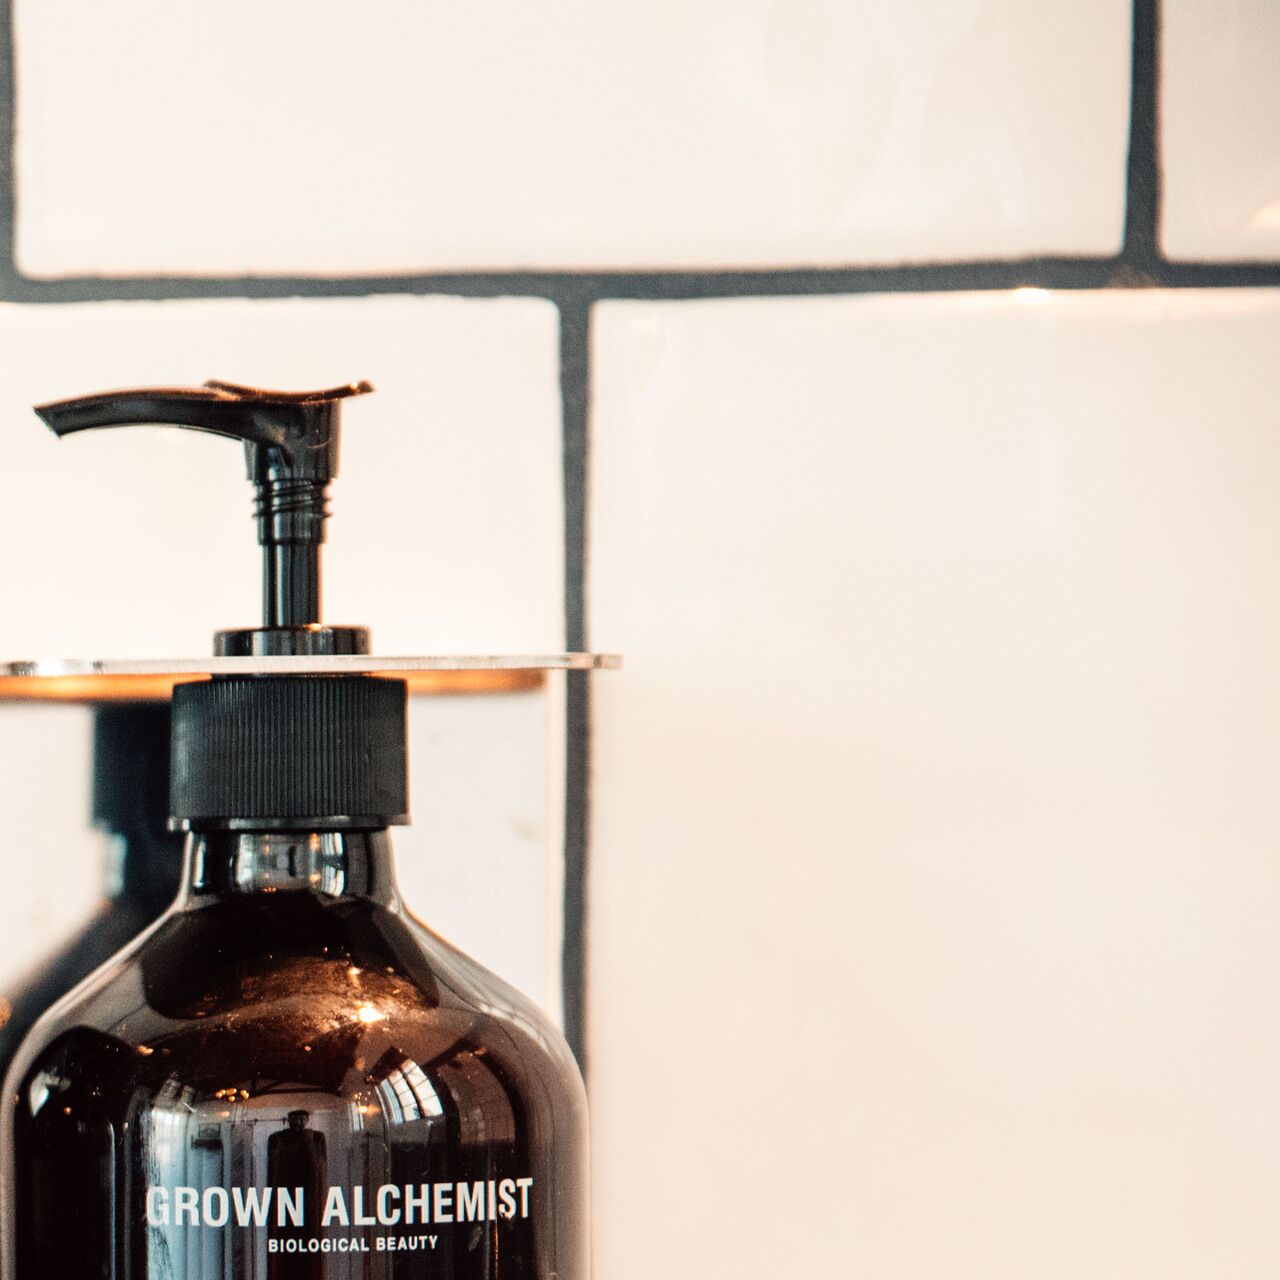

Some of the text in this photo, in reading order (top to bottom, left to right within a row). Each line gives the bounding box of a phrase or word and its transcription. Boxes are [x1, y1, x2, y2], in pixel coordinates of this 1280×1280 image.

[146, 1178, 533, 1227] GROWN ALCHEMIST
[268, 1235, 439, 1253] BIOLOGICAL BEAUTY
